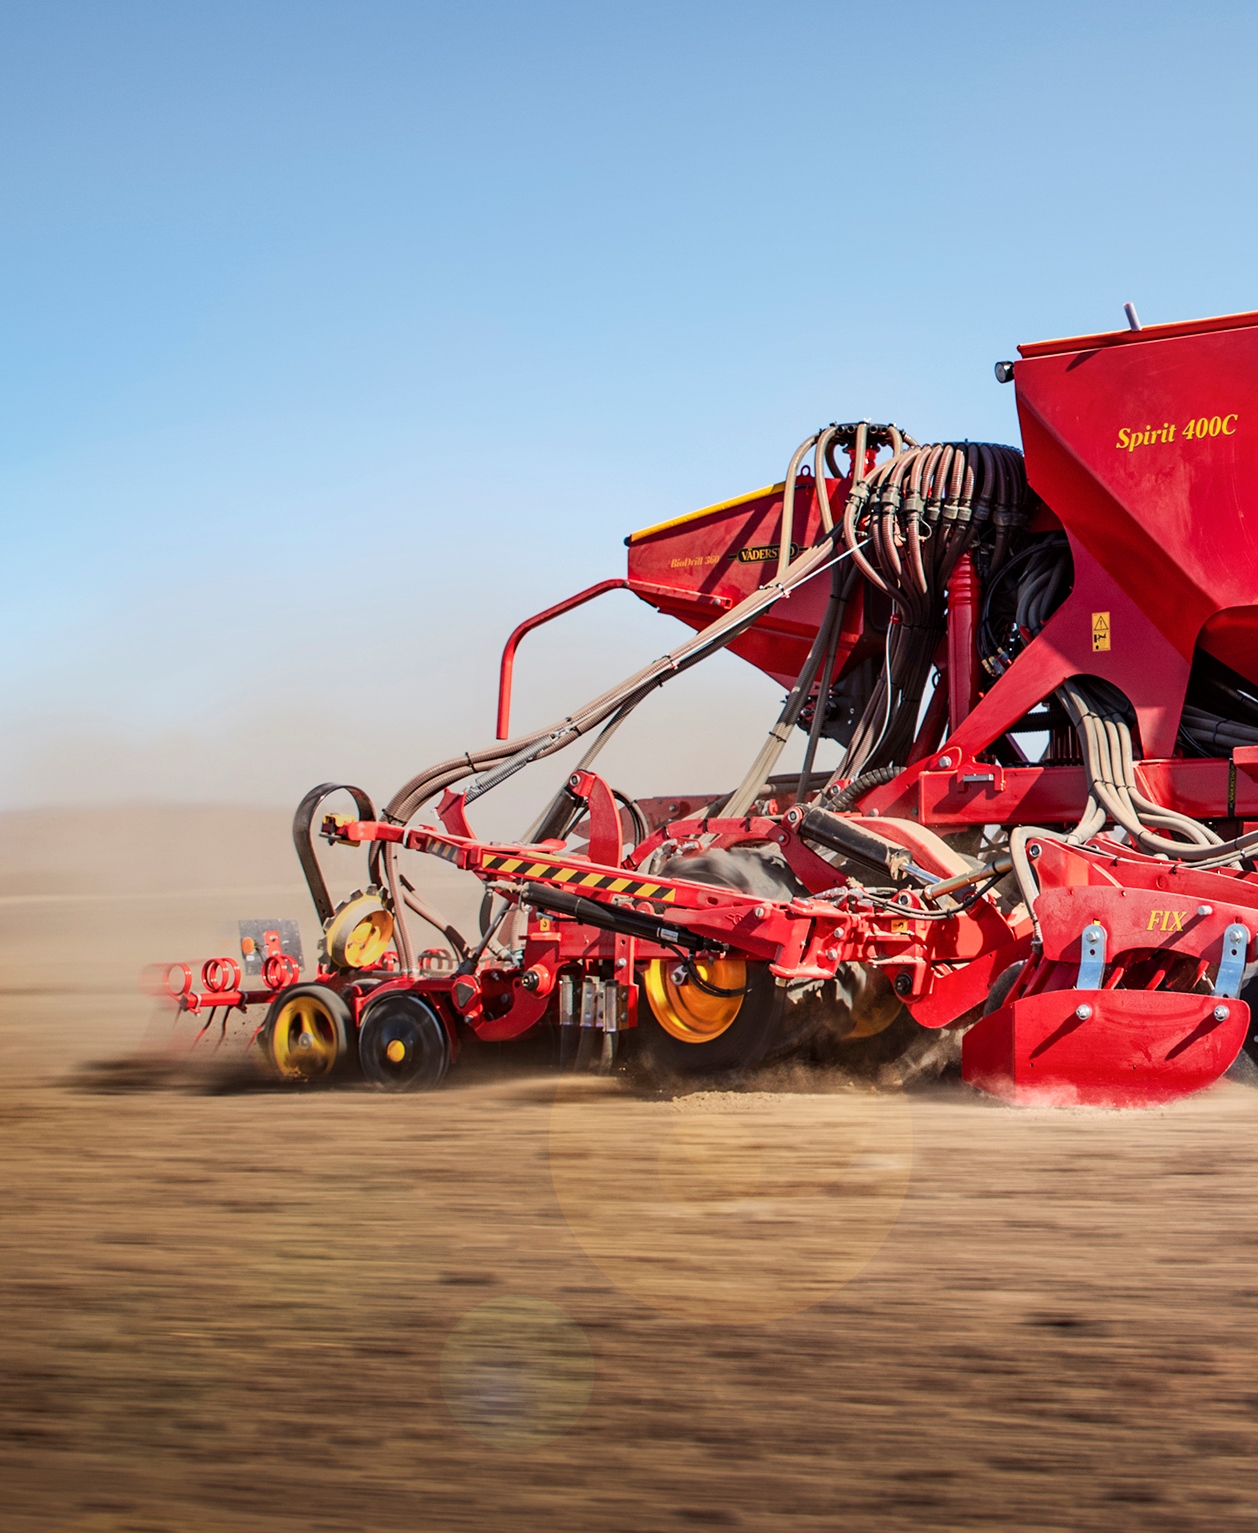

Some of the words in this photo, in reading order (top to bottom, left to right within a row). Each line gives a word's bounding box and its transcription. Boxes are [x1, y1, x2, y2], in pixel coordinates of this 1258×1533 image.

[1116, 422, 1177, 453] Spirit
[1182, 413, 1239, 440] 400C
[671, 556, 703, 568] BioDrill
[741, 546, 795, 561] VÄDERS
[1146, 909, 1188, 932] FIX
